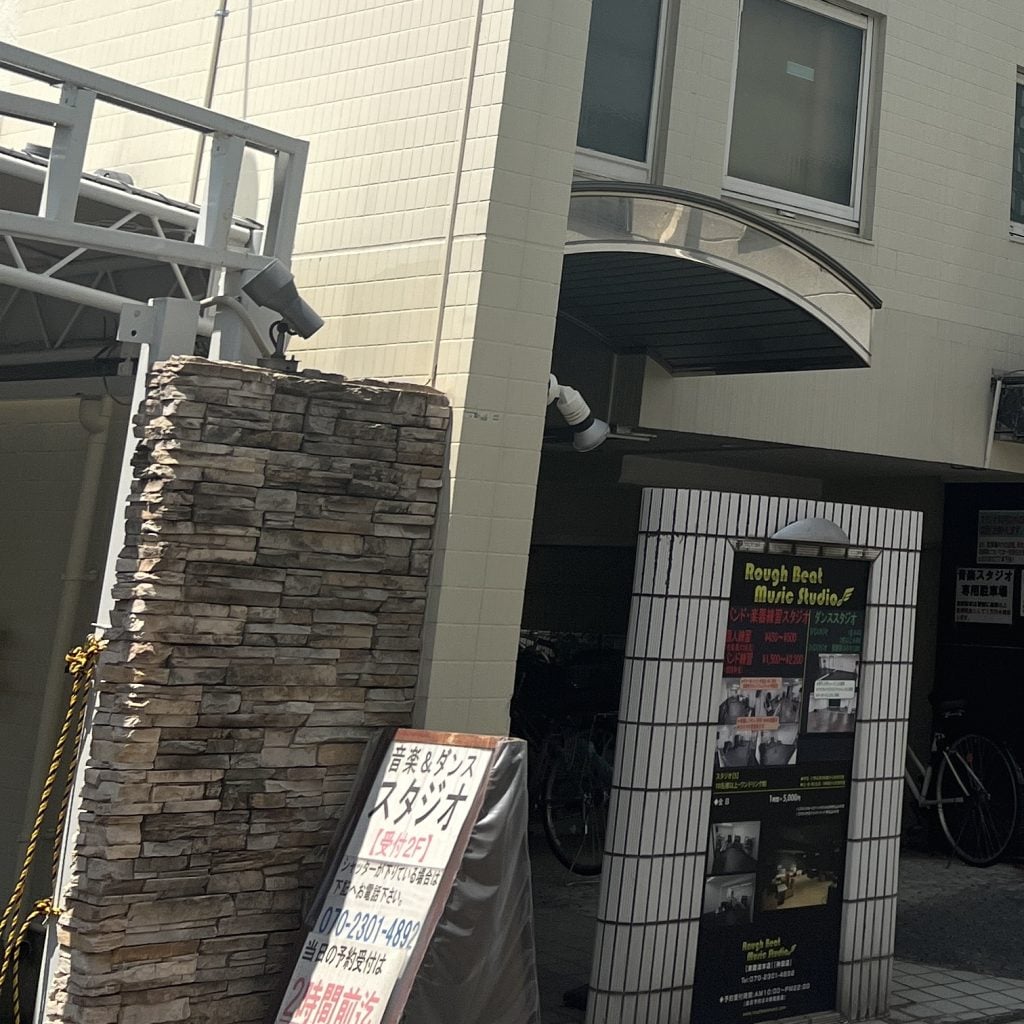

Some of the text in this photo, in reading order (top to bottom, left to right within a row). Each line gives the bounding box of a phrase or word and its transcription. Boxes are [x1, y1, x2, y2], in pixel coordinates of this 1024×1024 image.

[745, 563, 823, 587] Rough Beat
[754, 585, 838, 606] Music Studio
[388, 745, 477, 777] 音楽&ダンス
[368, 778, 468, 831] スタジオ
[319, 906, 421, 951] 070-2301-4892
[302, 939, 387, 975] 当日の予約受付は
